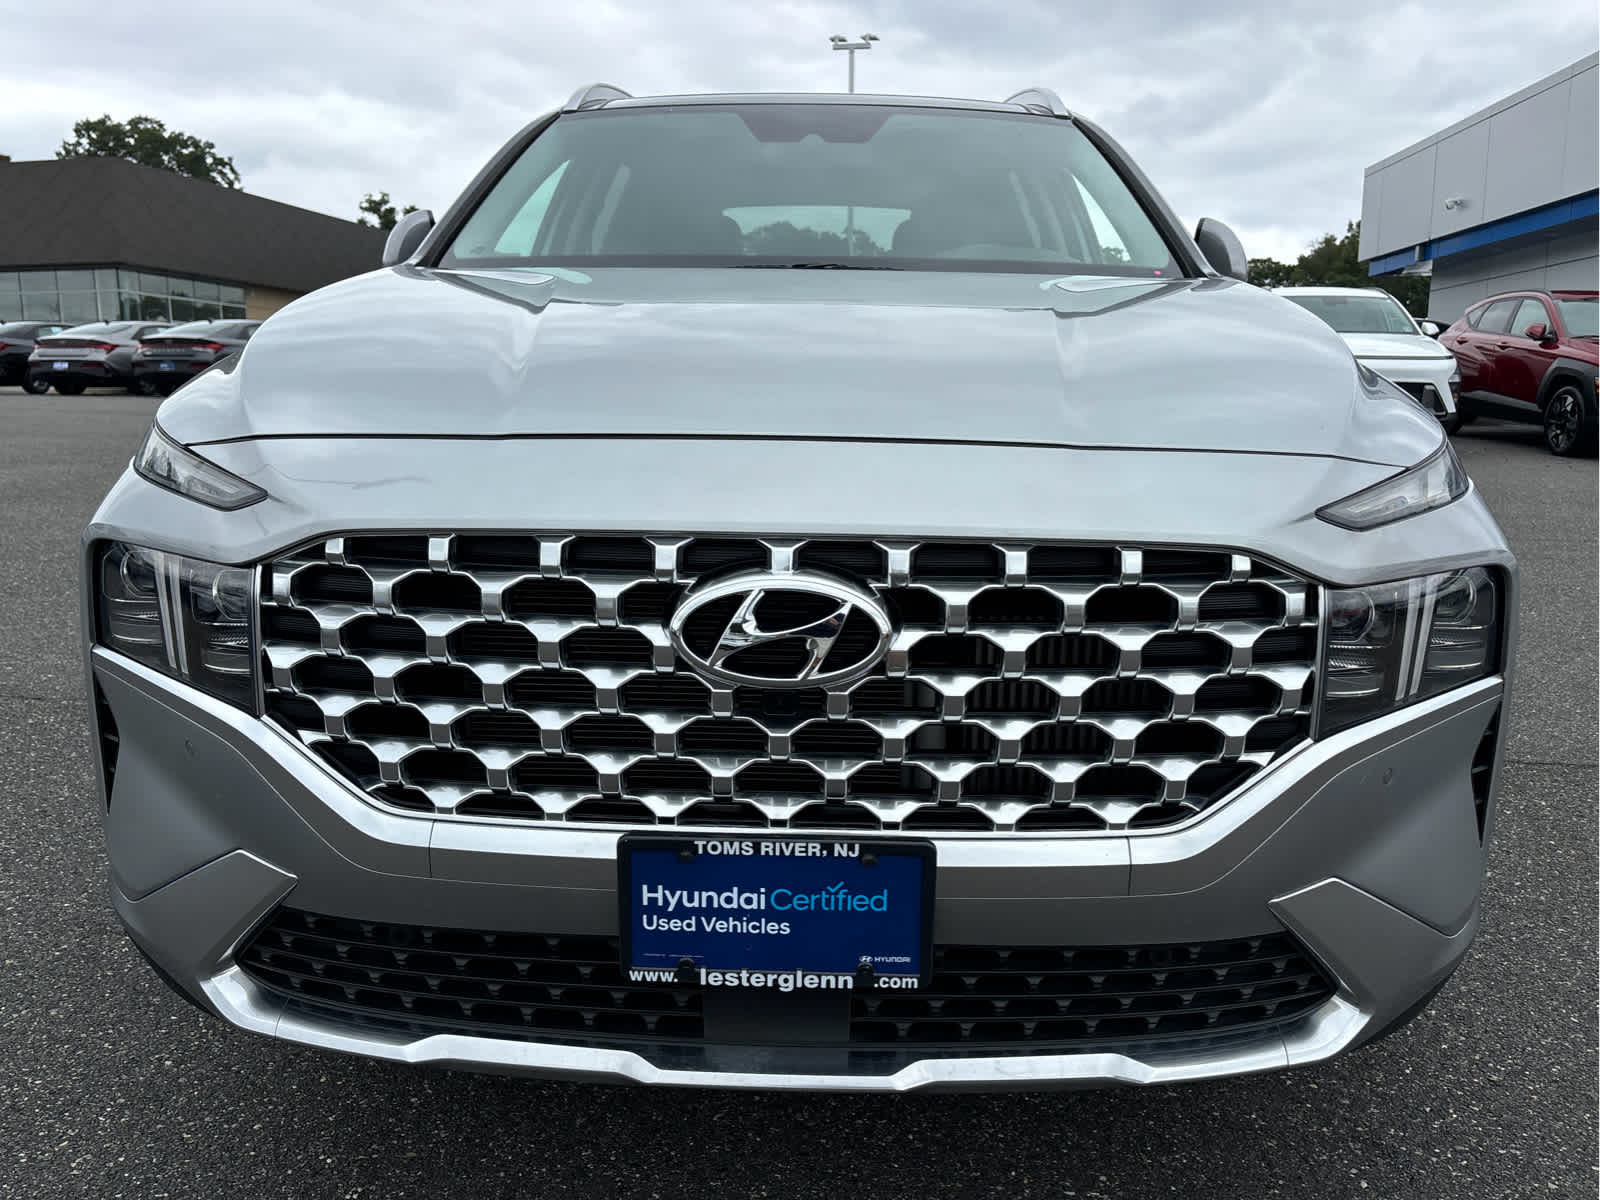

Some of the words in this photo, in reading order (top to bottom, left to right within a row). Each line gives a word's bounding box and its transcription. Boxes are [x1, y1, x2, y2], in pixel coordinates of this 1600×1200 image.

[694, 840, 754, 856] TOMS
[760, 841, 828, 858] RIVER,
[833, 843, 860, 858] NJ
[642, 884, 766, 912] Hyundai
[770, 881, 888, 912] Certified
[642, 914, 697, 932] Used
[700, 916, 791, 935] Vehicles
